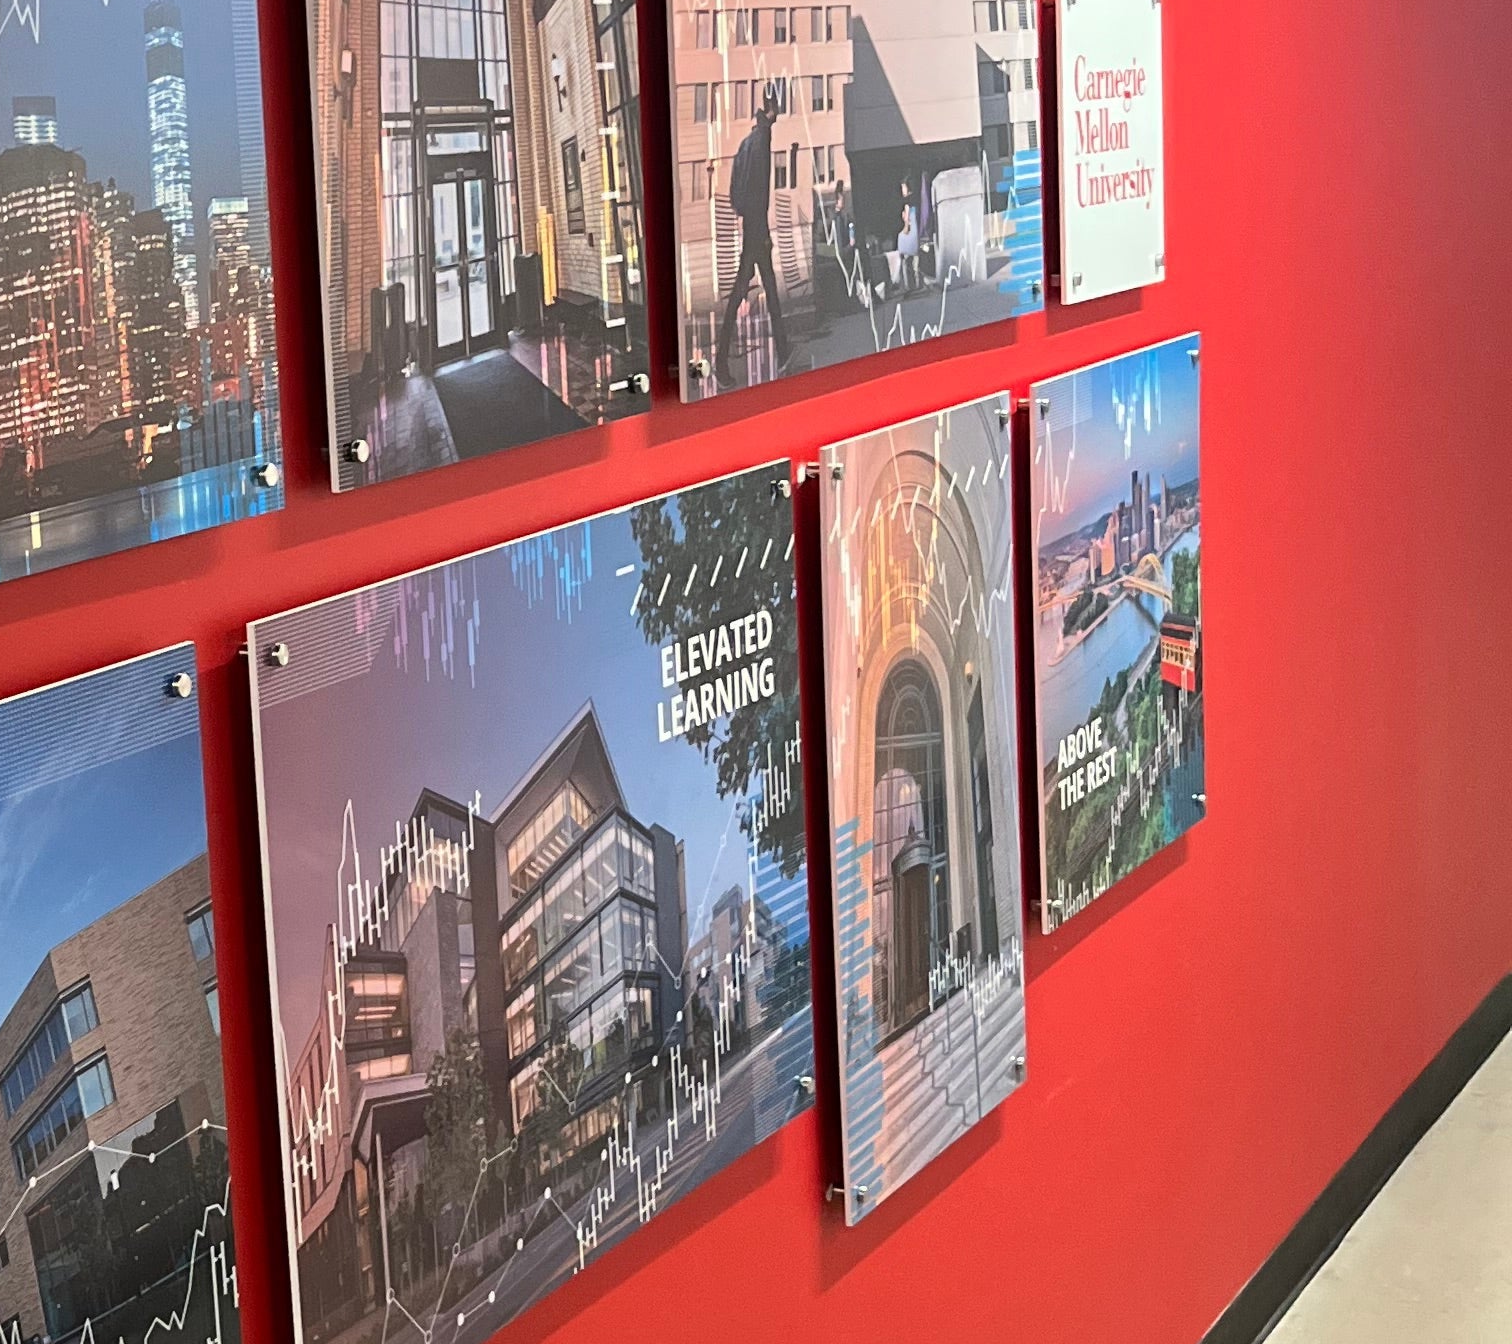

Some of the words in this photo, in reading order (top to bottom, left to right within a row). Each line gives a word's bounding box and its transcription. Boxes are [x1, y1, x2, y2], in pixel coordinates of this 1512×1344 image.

[1074, 54, 1146, 113] Carnegie
[1074, 107, 1129, 156] Mellon
[1076, 158, 1155, 210] University
[661, 610, 774, 689] ELEVATED
[657, 657, 776, 743] LEARNING
[1057, 716, 1103, 773] ABOVE
[1057, 767, 1085, 811] THE
[1087, 746, 1117, 793] REST
